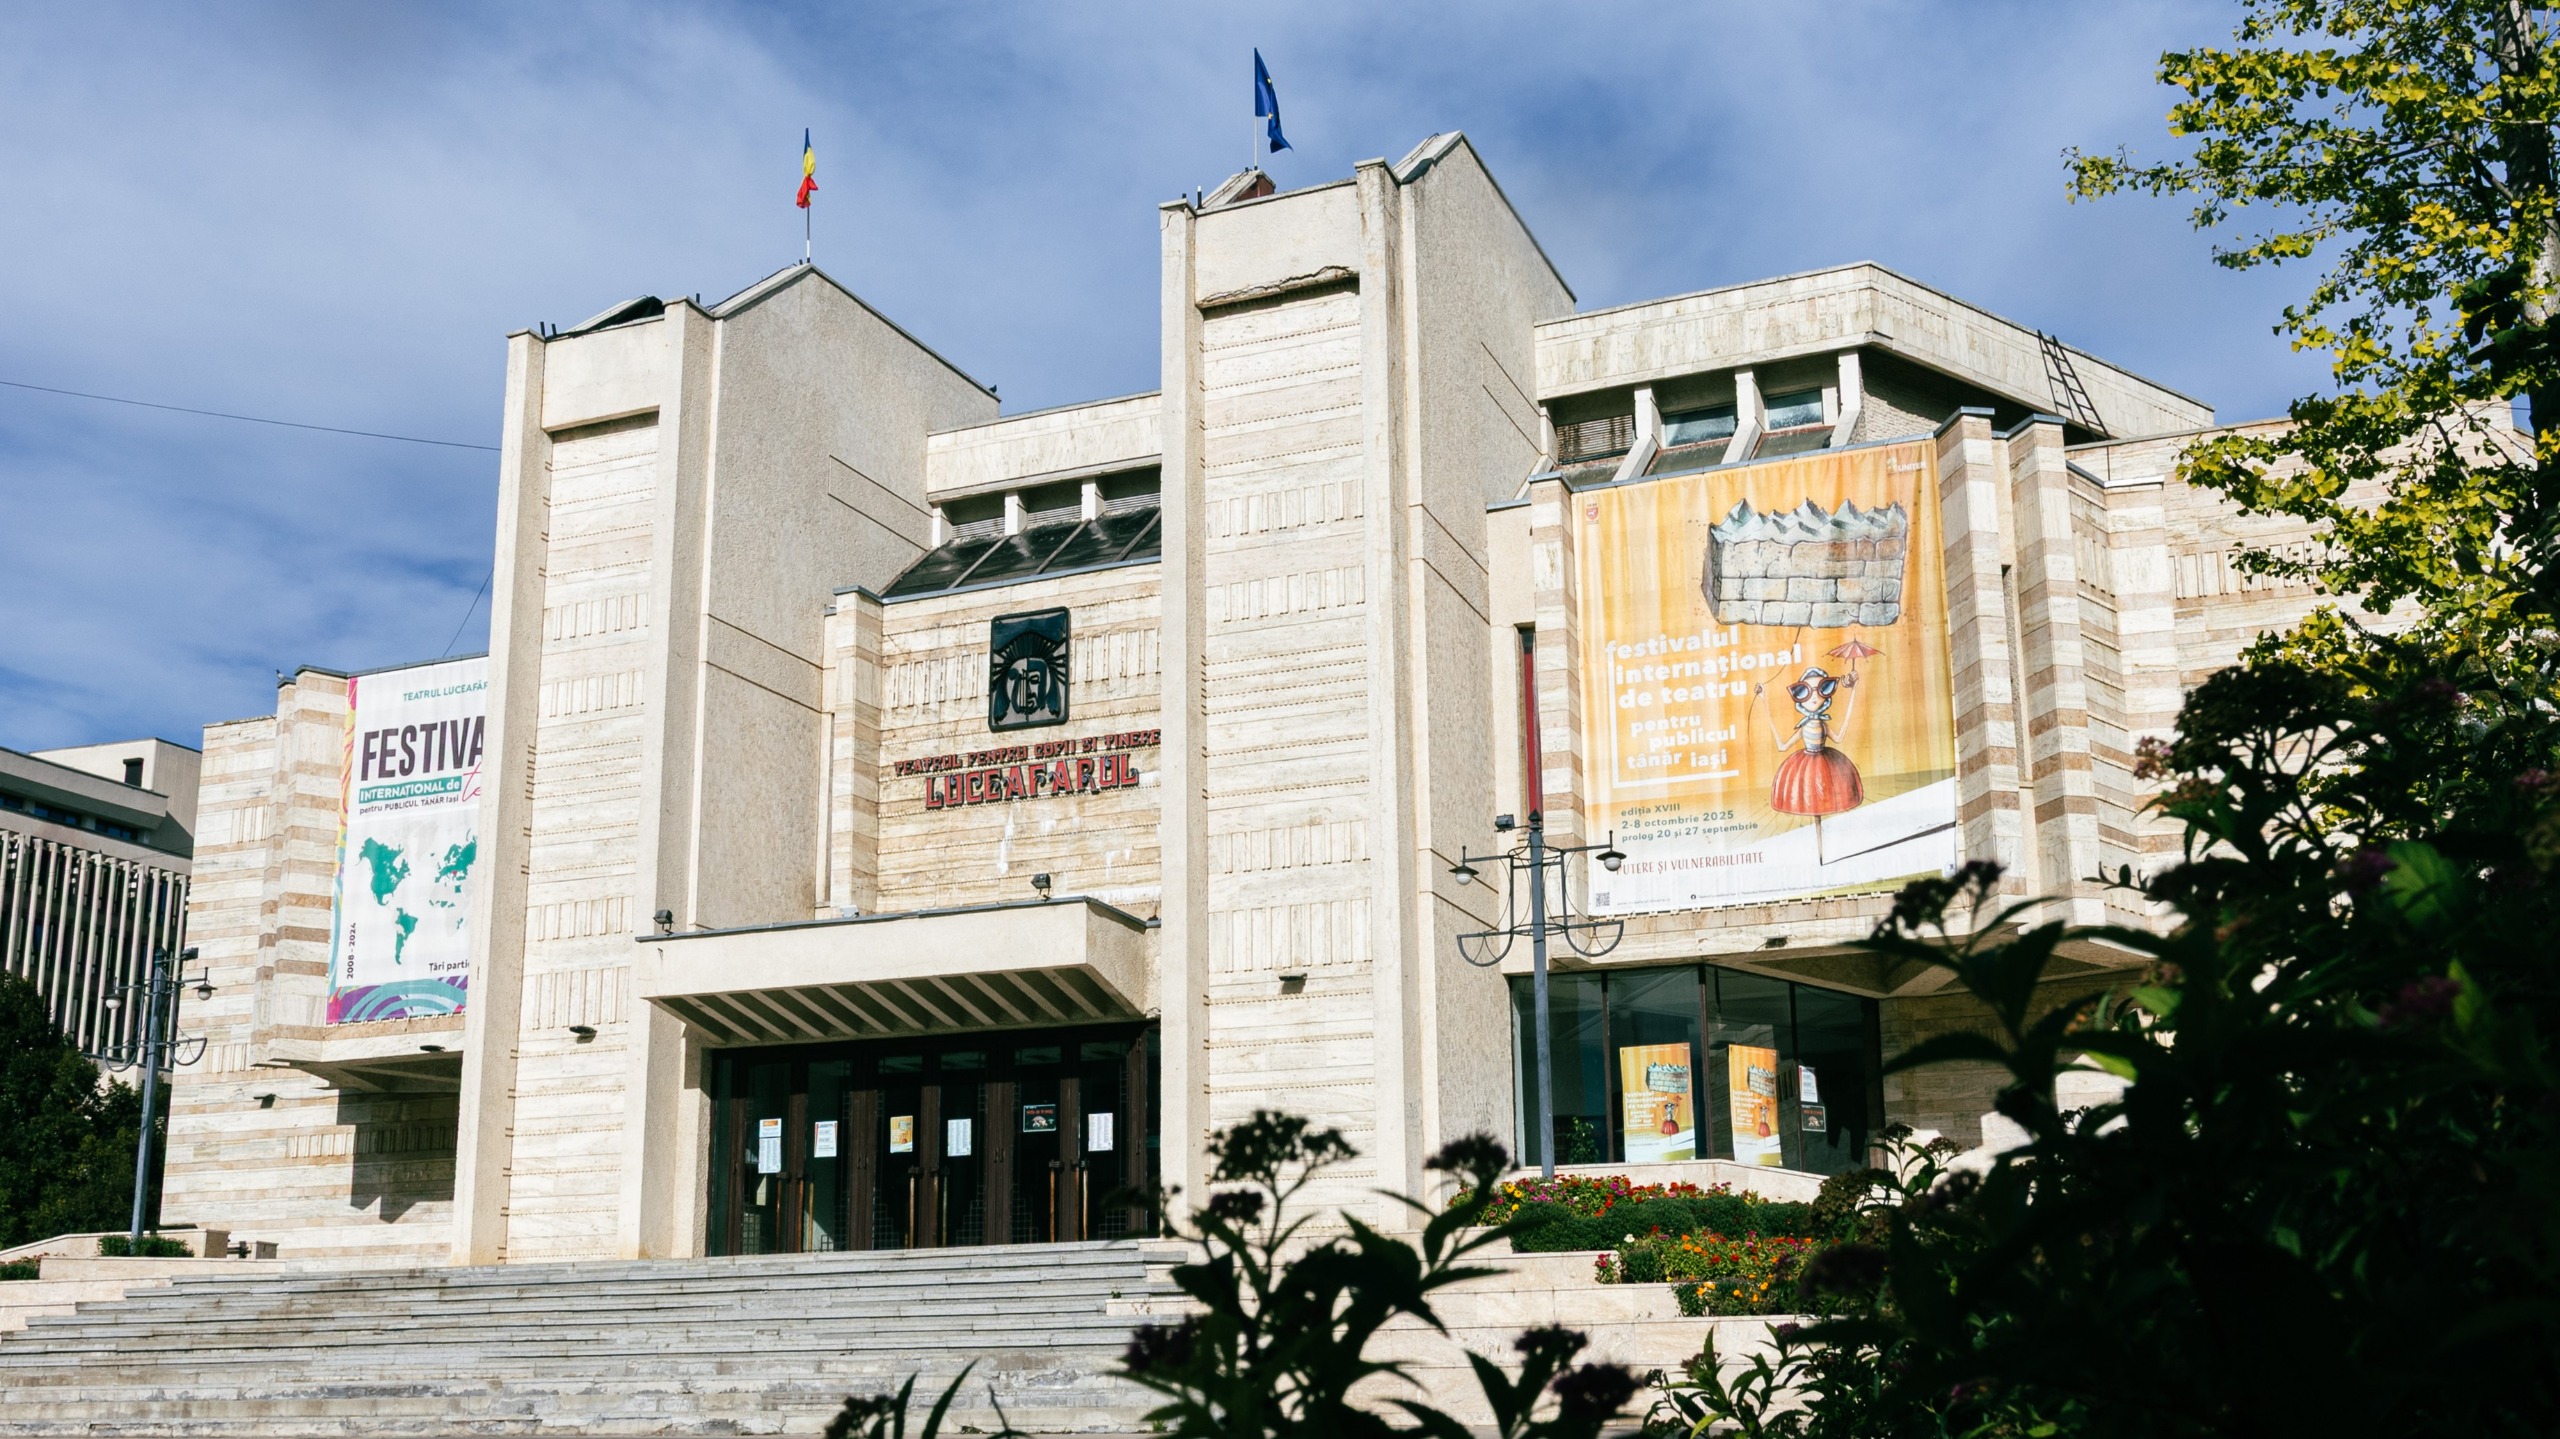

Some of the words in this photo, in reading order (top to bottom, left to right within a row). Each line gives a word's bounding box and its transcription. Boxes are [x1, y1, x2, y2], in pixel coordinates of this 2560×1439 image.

[1605, 625, 1739, 659] festivalul
[1616, 643, 1802, 685] internațional
[403, 688, 441, 702] TEATRUL
[1618, 688, 1652, 709] de
[1660, 680, 1748, 705] teatru
[1630, 714, 1701, 738] pentru
[1650, 724, 1737, 752] publicul
[360, 715, 485, 781] FESTIVA
[894, 754, 963, 777] TEATRUL
[966, 745, 1029, 767] PENTRU
[1033, 739, 1077, 758] COPII
[1081, 736, 1098, 753] SI
[1627, 751, 1682, 769] tânăr
[1690, 749, 1728, 769] iași
[360, 784, 443, 801] INTERNAȚIONAL
[446, 780, 460, 791] de
[925, 753, 1140, 810] LUCEAFARUL
[359, 804, 383, 815] pentru
[384, 800, 419, 811] PUBLICUL
[1621, 806, 1651, 817] ediția
[1655, 803, 1680, 813] XVIII
[1621, 820, 1641, 829] 2-8
[1644, 815, 1699, 828] octombrie
[1703, 810, 1734, 822] 2025
[1622, 832, 1654, 843] prolog
[1657, 829, 1671, 839] 20
[1674, 829, 1682, 839] și
[1685, 827, 1699, 836] 27
[1702, 822, 1759, 835] septembrie
[1657, 860, 1667, 875] ȘI
[1670, 851, 1764, 871] VULNERABILITATE
[346, 954, 354, 979] 2008
